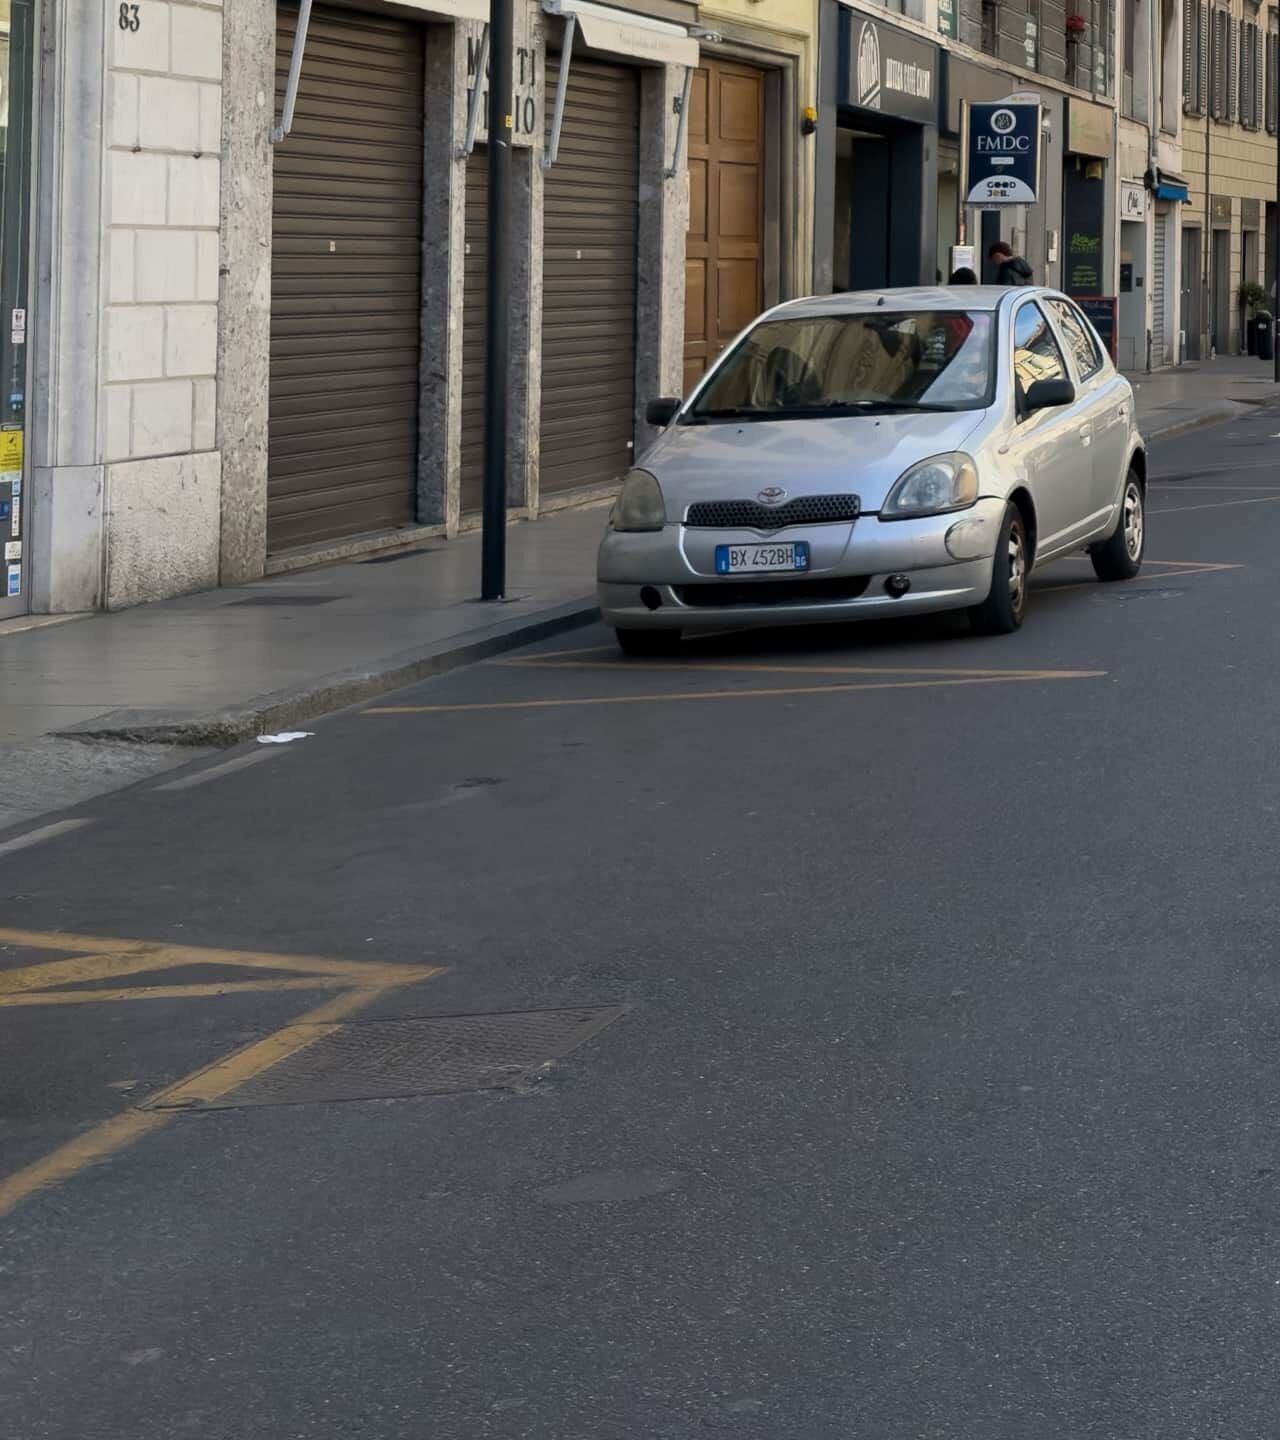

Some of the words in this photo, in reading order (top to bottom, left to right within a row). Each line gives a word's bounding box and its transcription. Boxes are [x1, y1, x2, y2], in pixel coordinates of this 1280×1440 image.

[119, 2, 140, 32] 83
[977, 135, 1030, 151] FMDC
[987, 181, 1016, 189] GOOD
[731, 549, 748, 567] BX
[752, 546, 794, 566] 452BH
